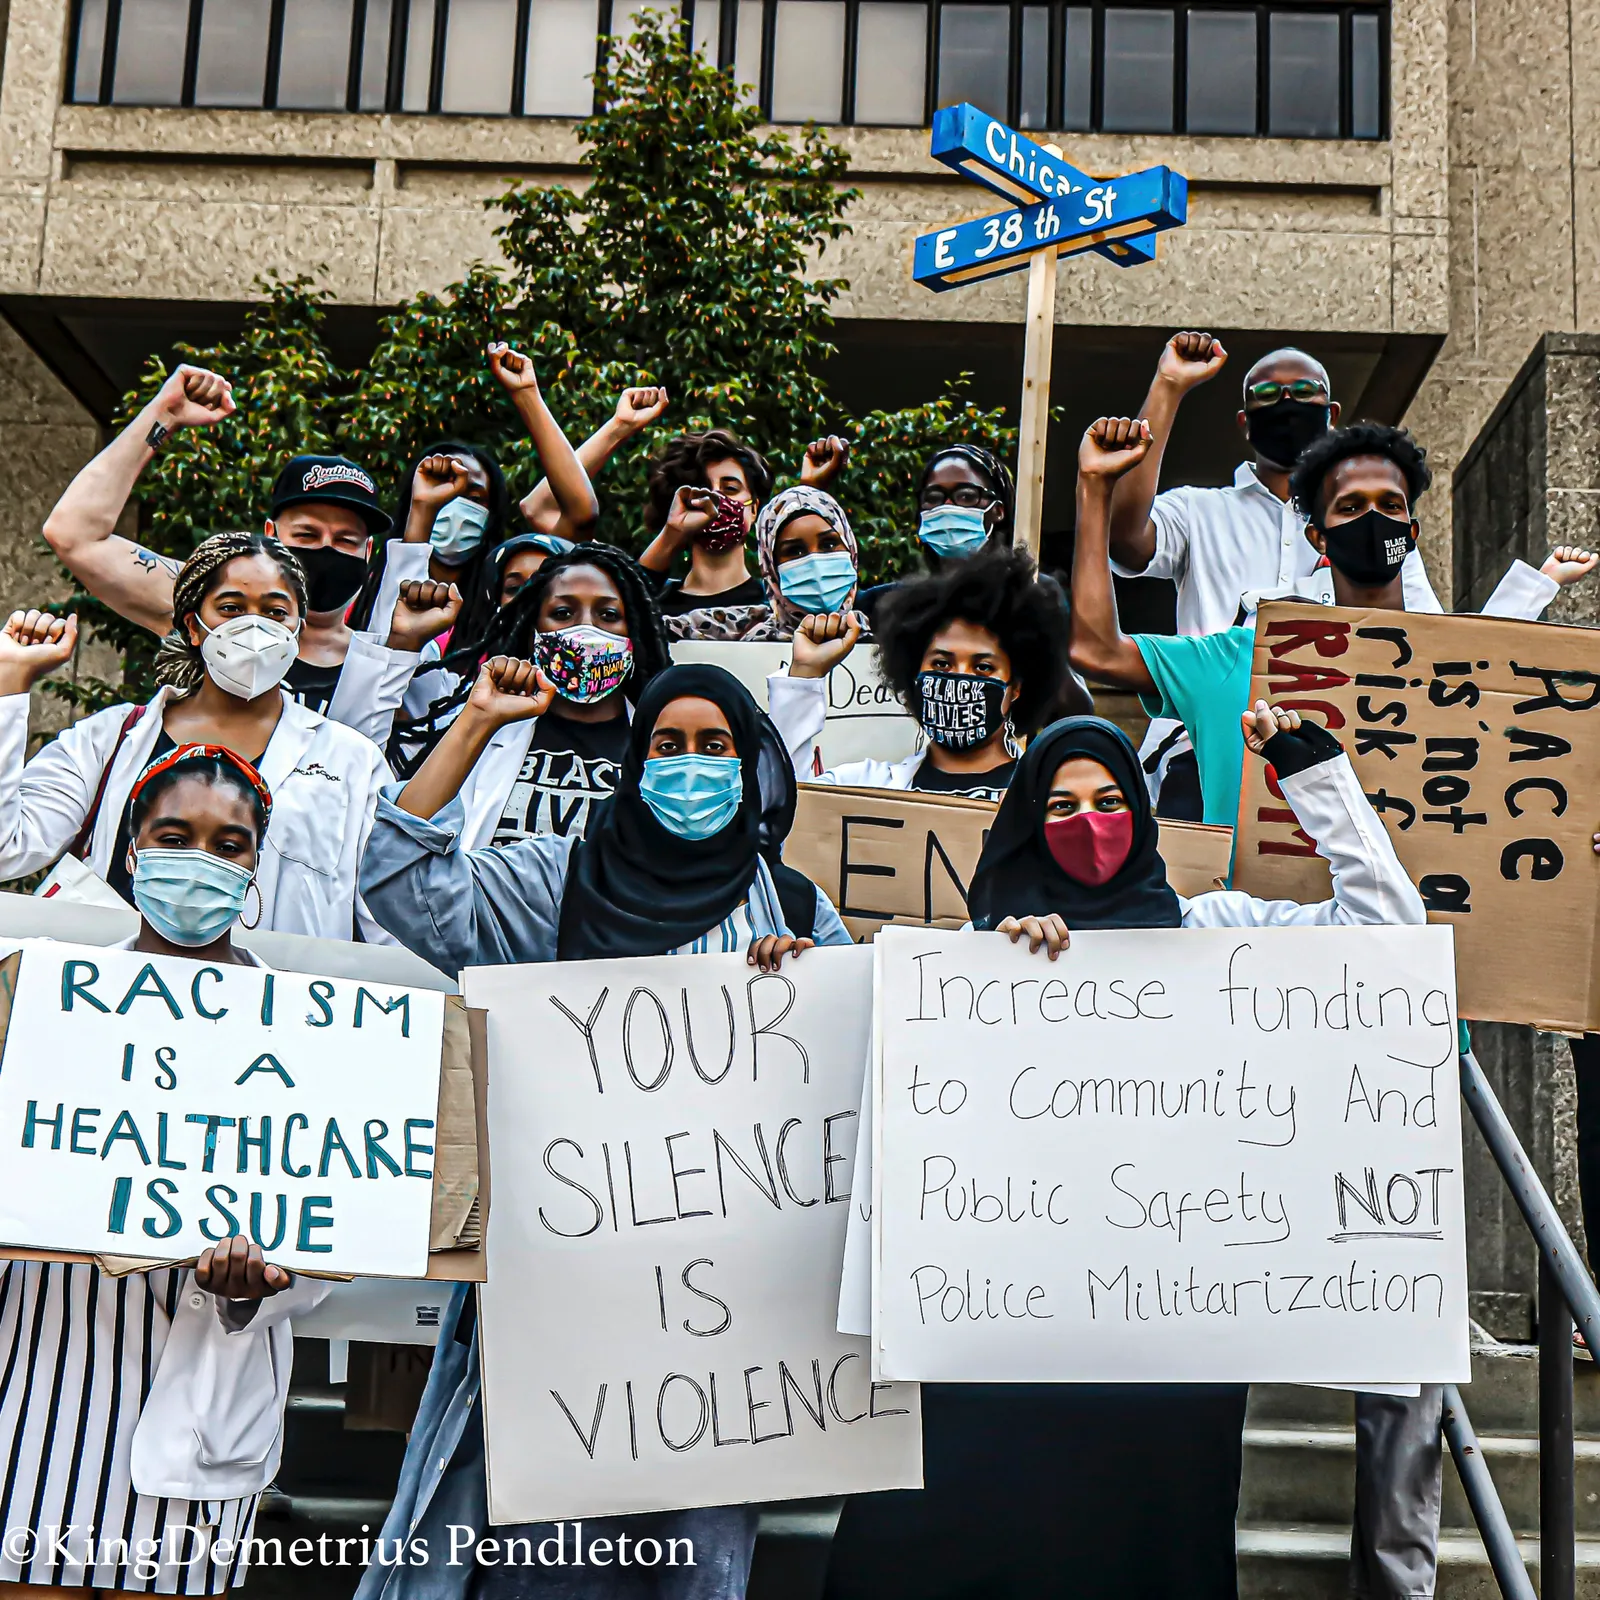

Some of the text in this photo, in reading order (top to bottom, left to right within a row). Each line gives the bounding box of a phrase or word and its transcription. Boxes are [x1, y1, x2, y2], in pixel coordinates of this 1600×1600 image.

[985, 121, 1082, 197] Chica
[934, 185, 1117, 269] E 38 th St
[1384, 536, 1407, 548] BLACK
[1386, 545, 1406, 556] LIVES
[828, 662, 906, 709] Dea
[922, 676, 986, 703] BLACK
[923, 700, 986, 730] LIVES
[1354, 626, 1418, 761] risk
[1428, 660, 1490, 710] is
[517, 754, 622, 790] BLAC
[1421, 737, 1488, 834] not
[840, 815, 991, 924] EN
[61, 959, 411, 1038] RACISM
[548, 972, 810, 1094] YOUR
[905, 943, 1453, 1068] Increase funding
[121, 1043, 296, 1090] IS A
[906, 1060, 1438, 1147] to Community And
[21, 1100, 435, 1180] HEALTHCARE
[538, 1110, 858, 1238] SILENCE
[107, 1176, 334, 1253] ISSUE
[920, 1154, 1454, 1248] Public Safety NOT
[654, 1257, 732, 1337] IS
[910, 1260, 1444, 1325] Police Militarization
